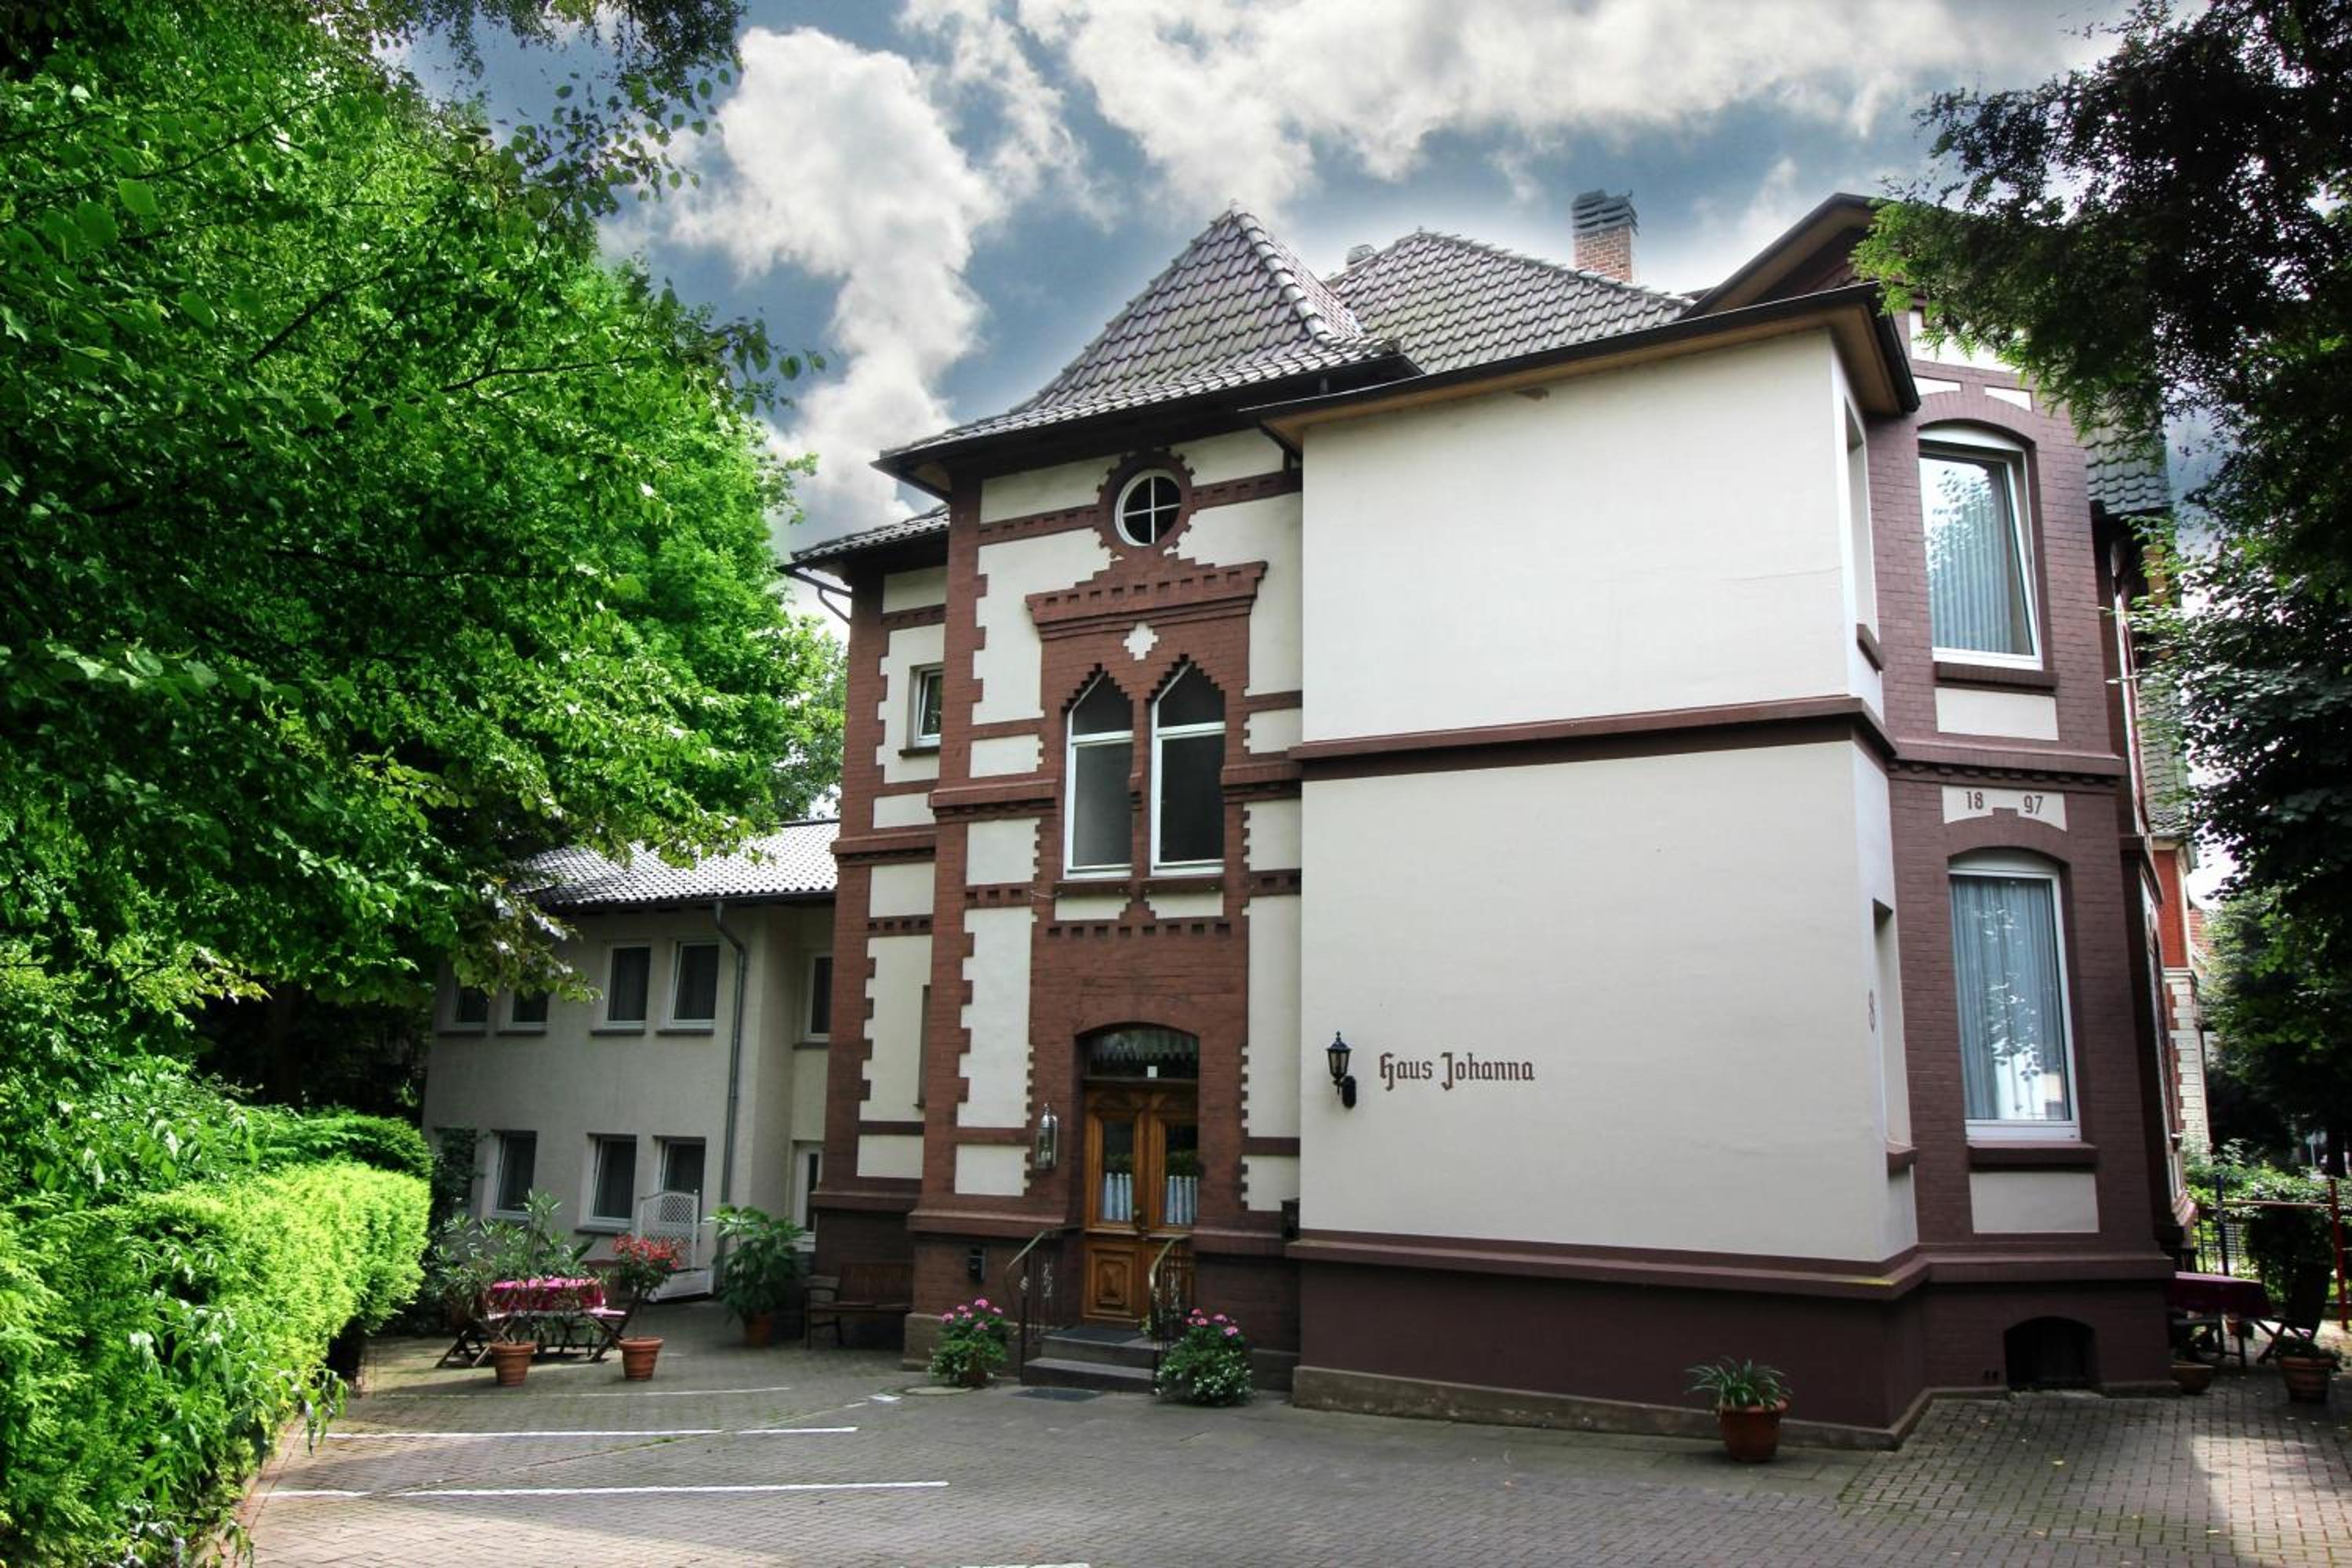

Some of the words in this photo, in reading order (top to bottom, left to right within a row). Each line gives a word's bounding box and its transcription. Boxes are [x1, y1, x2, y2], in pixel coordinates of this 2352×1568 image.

[1965, 791, 1984, 810] 18
[2024, 796, 2044, 815] 97
[1379, 1051, 1433, 1091] Haus
[1440, 1052, 1536, 1091] Johanna
